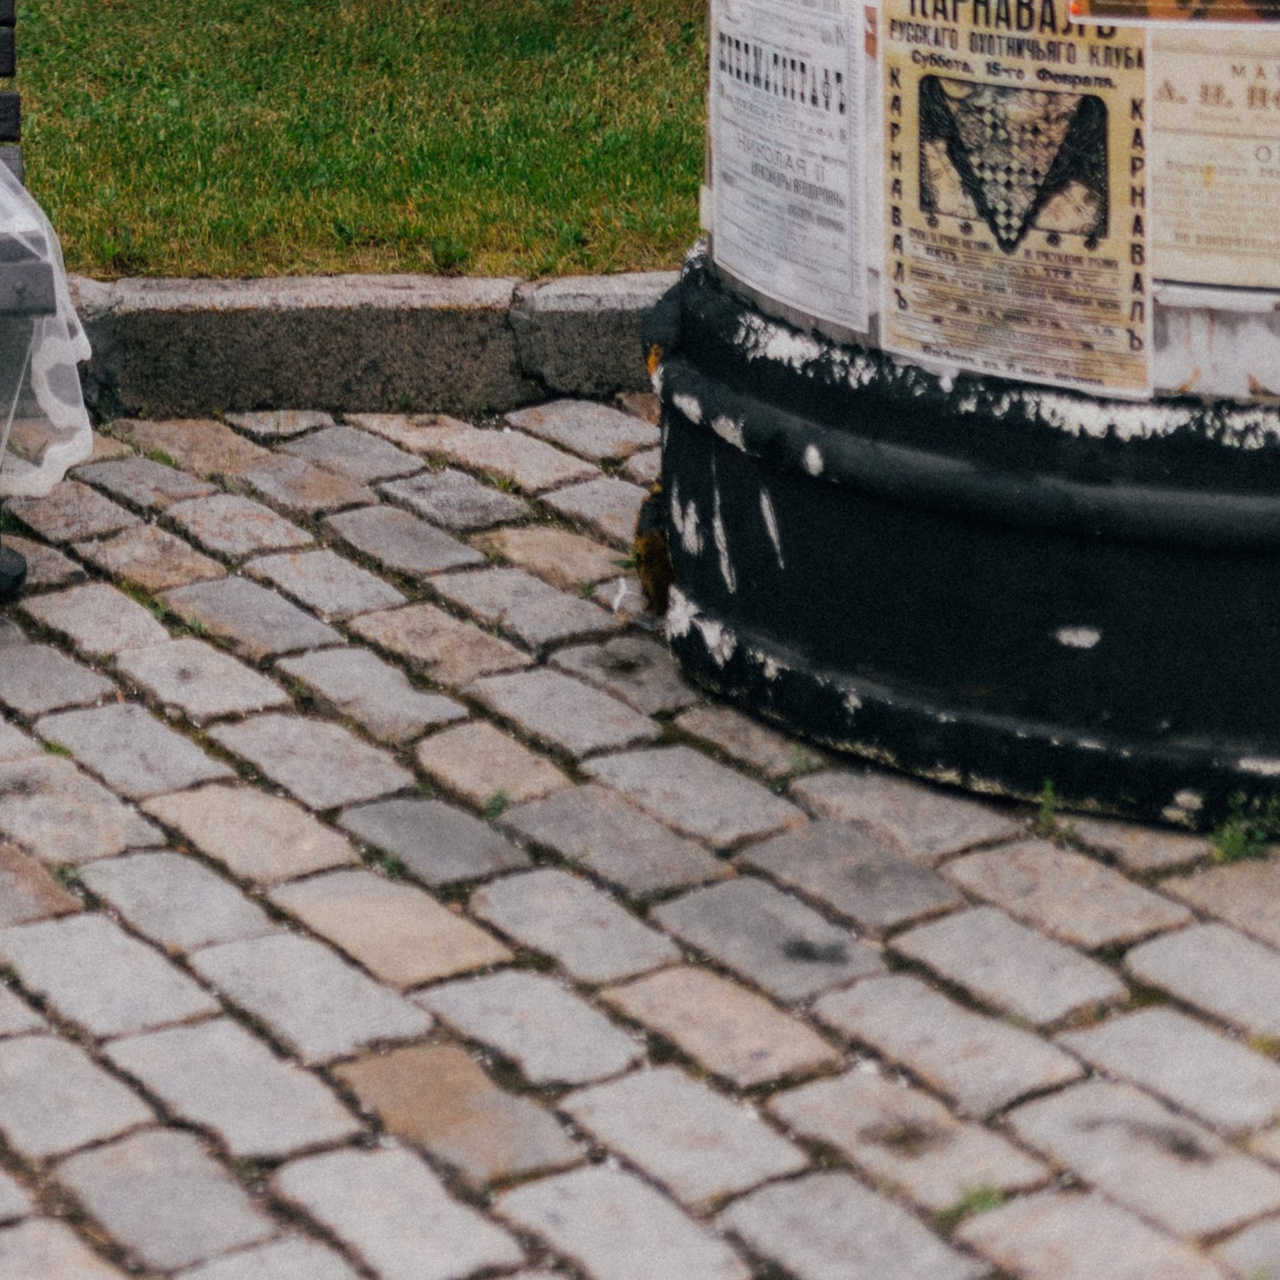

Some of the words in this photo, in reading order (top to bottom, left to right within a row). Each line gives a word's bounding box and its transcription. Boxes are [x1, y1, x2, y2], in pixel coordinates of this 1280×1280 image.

[890, 19, 959, 50] РУССКАГО
[970, 31, 1076, 66] ОХОТНИЧЬЯГО
[1089, 44, 1144, 70] КЛУБА
[985, 61, 1025, 81] 15-го
